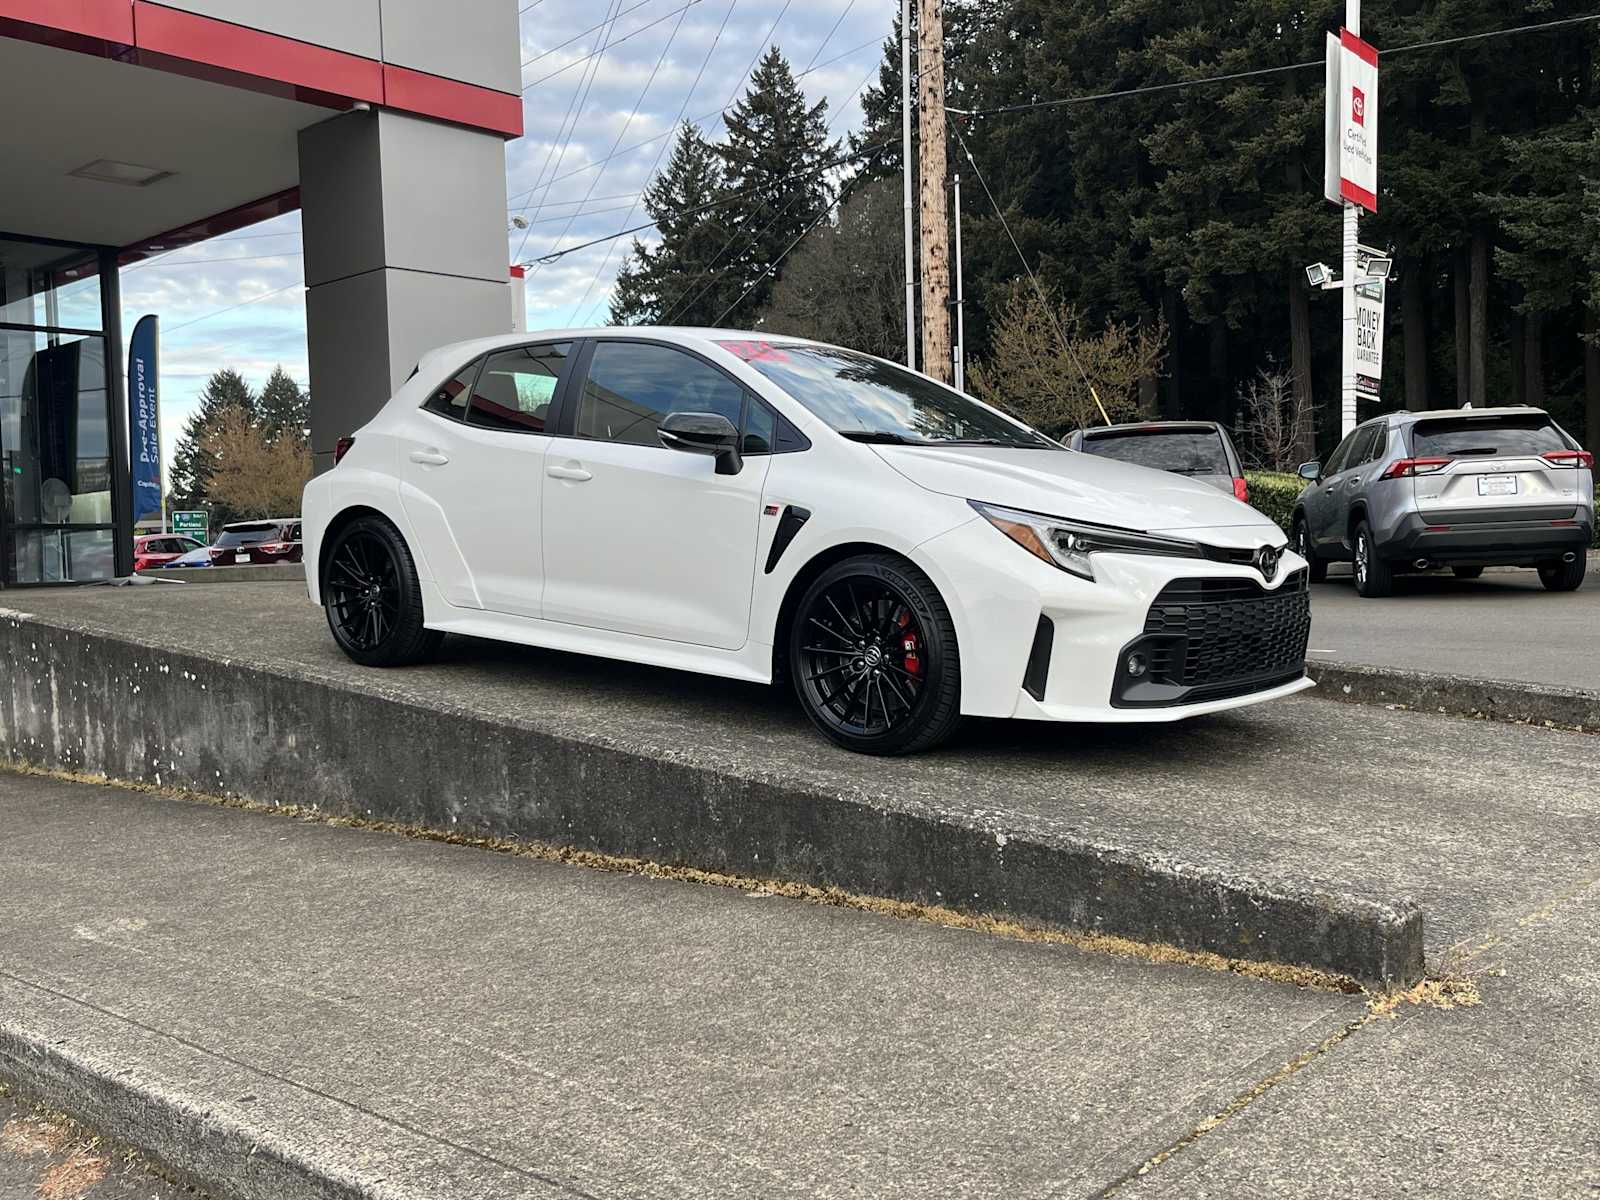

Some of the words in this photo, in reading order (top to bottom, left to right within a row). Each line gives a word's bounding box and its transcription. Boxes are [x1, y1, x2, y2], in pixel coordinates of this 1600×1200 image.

[1357, 327, 1377, 350] BACK
[1356, 348, 1379, 365] UARANTEE
[136, 357, 149, 463] Pre-Approval
[148, 386, 157, 429] Event
[150, 434, 159, 464] Sale
